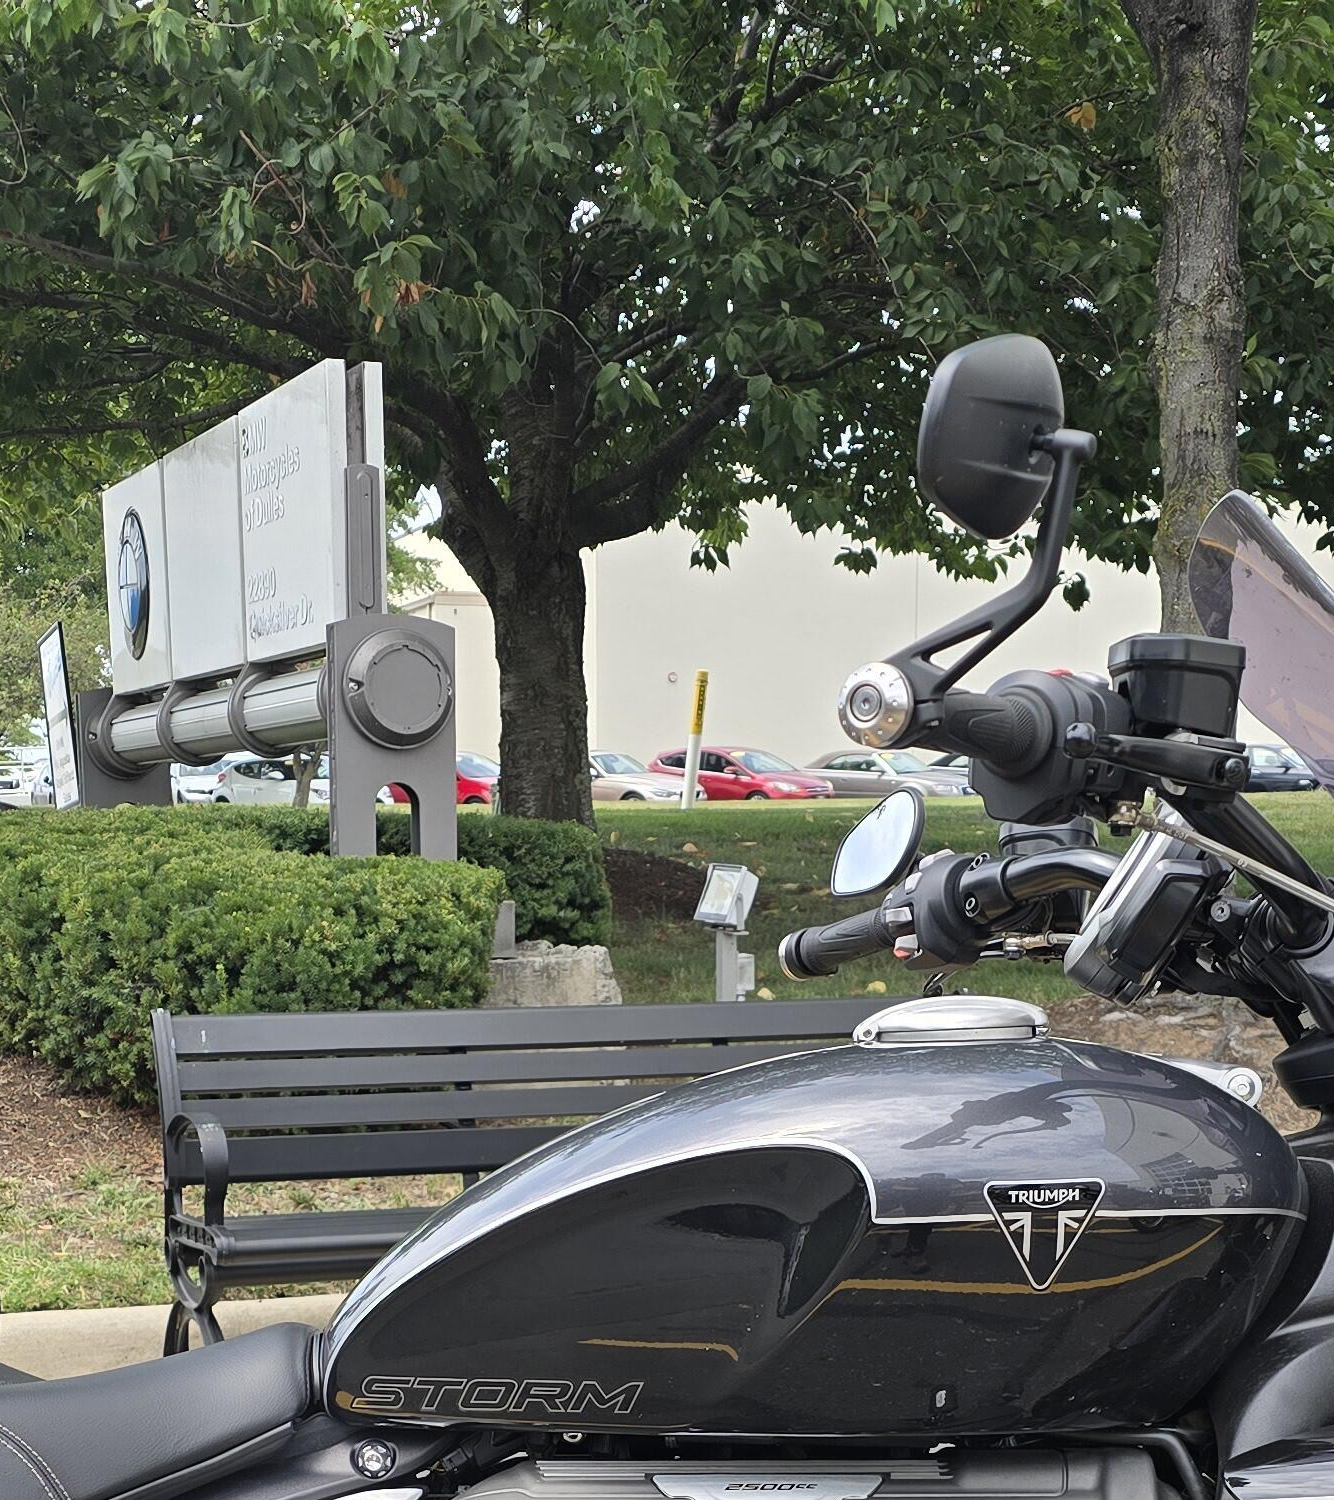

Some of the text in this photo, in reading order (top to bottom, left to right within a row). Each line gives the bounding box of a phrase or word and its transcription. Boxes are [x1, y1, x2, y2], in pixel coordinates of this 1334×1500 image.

[242, 416, 266, 459] BMW
[245, 443, 300, 496] Motorcycles
[246, 490, 285, 533] of Dulles
[248, 567, 277, 604] 22890
[249, 600, 300, 641] Quicksilver
[1008, 1188, 1080, 1208] TRIUMPH
[350, 1375, 645, 1415] STORM
